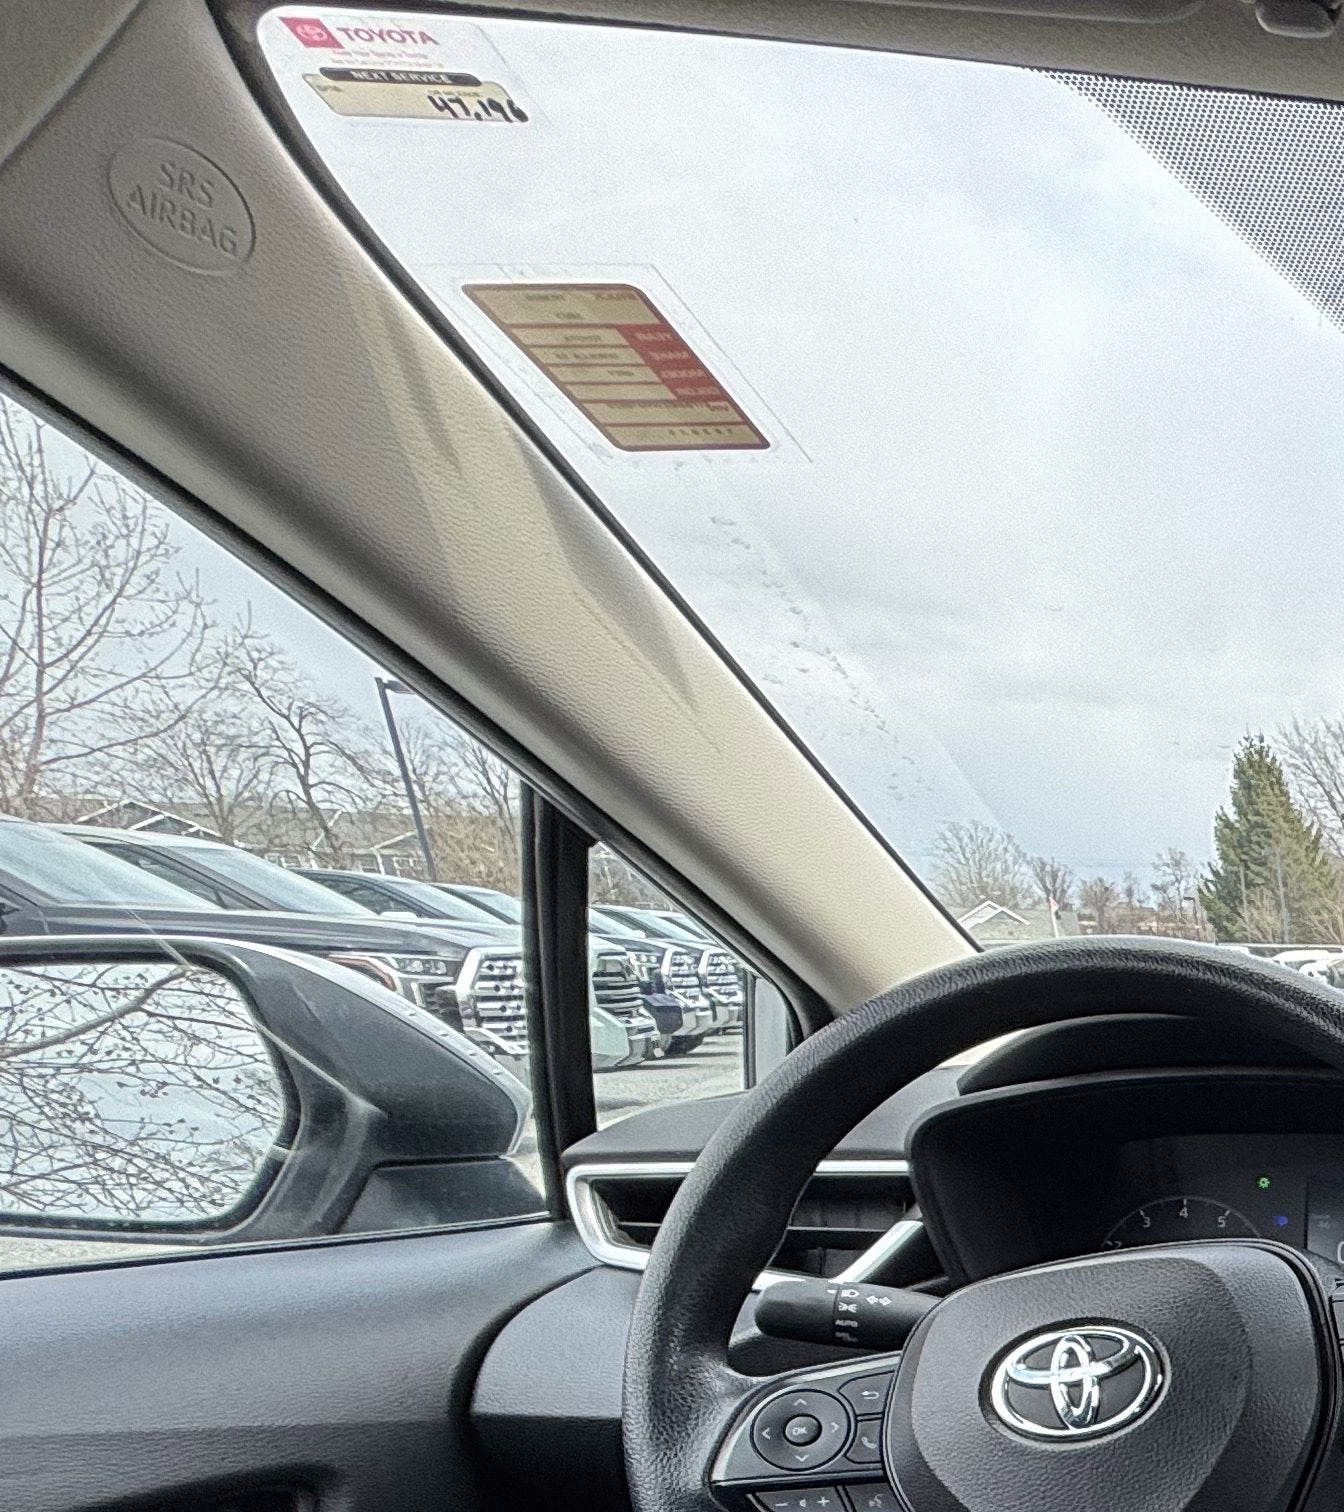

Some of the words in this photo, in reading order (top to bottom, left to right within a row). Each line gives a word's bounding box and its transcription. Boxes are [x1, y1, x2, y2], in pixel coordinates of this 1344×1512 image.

[337, 26, 441, 46] TOYOTA
[350, 70, 389, 82] NEXT
[392, 72, 453, 84] SERVICE
[159, 160, 214, 209] SRS
[128, 183, 239, 255] AIRBAG
[1179, 1206, 1189, 1219] 4
[1143, 1216, 1152, 1229] 3
[1217, 1215, 1226, 1228] 5
[835, 1319, 859, 1328] AUTO
[792, 1426, 808, 1436] OK
